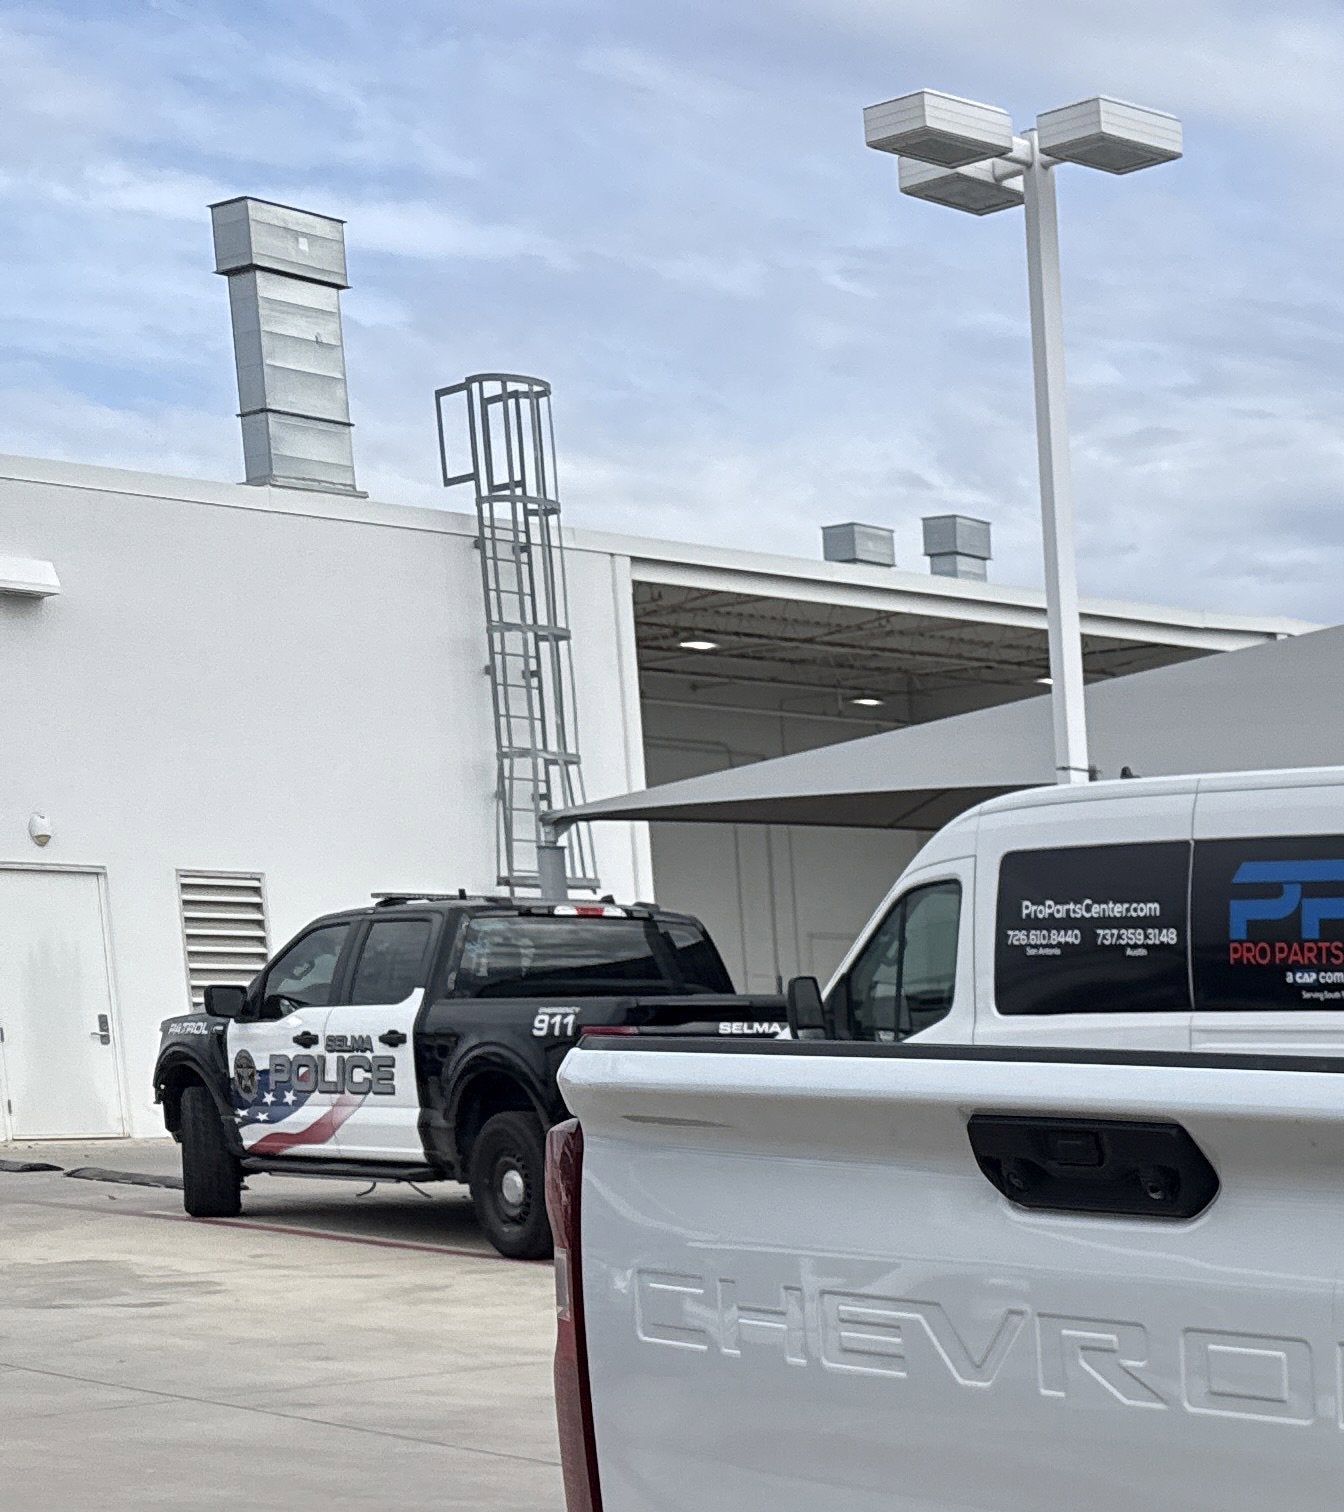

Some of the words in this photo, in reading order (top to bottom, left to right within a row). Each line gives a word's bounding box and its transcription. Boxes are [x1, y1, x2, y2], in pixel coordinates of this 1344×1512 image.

[1021, 898, 1160, 919] ProPartsCenter.com
[1007, 929, 1081, 945] 726.610.8440
[1096, 928, 1178, 945] 737.359.3148
[1229, 941, 1271, 965] PRO
[1275, 941, 1344, 965] PARTS
[1286, 971, 1294, 984] a
[168, 1021, 208, 1035] PATROL
[532, 1014, 576, 1037] 911
[718, 1021, 782, 1034] SELMA
[325, 1035, 375, 1053] SELMA
[268, 1053, 396, 1096] POLICE
